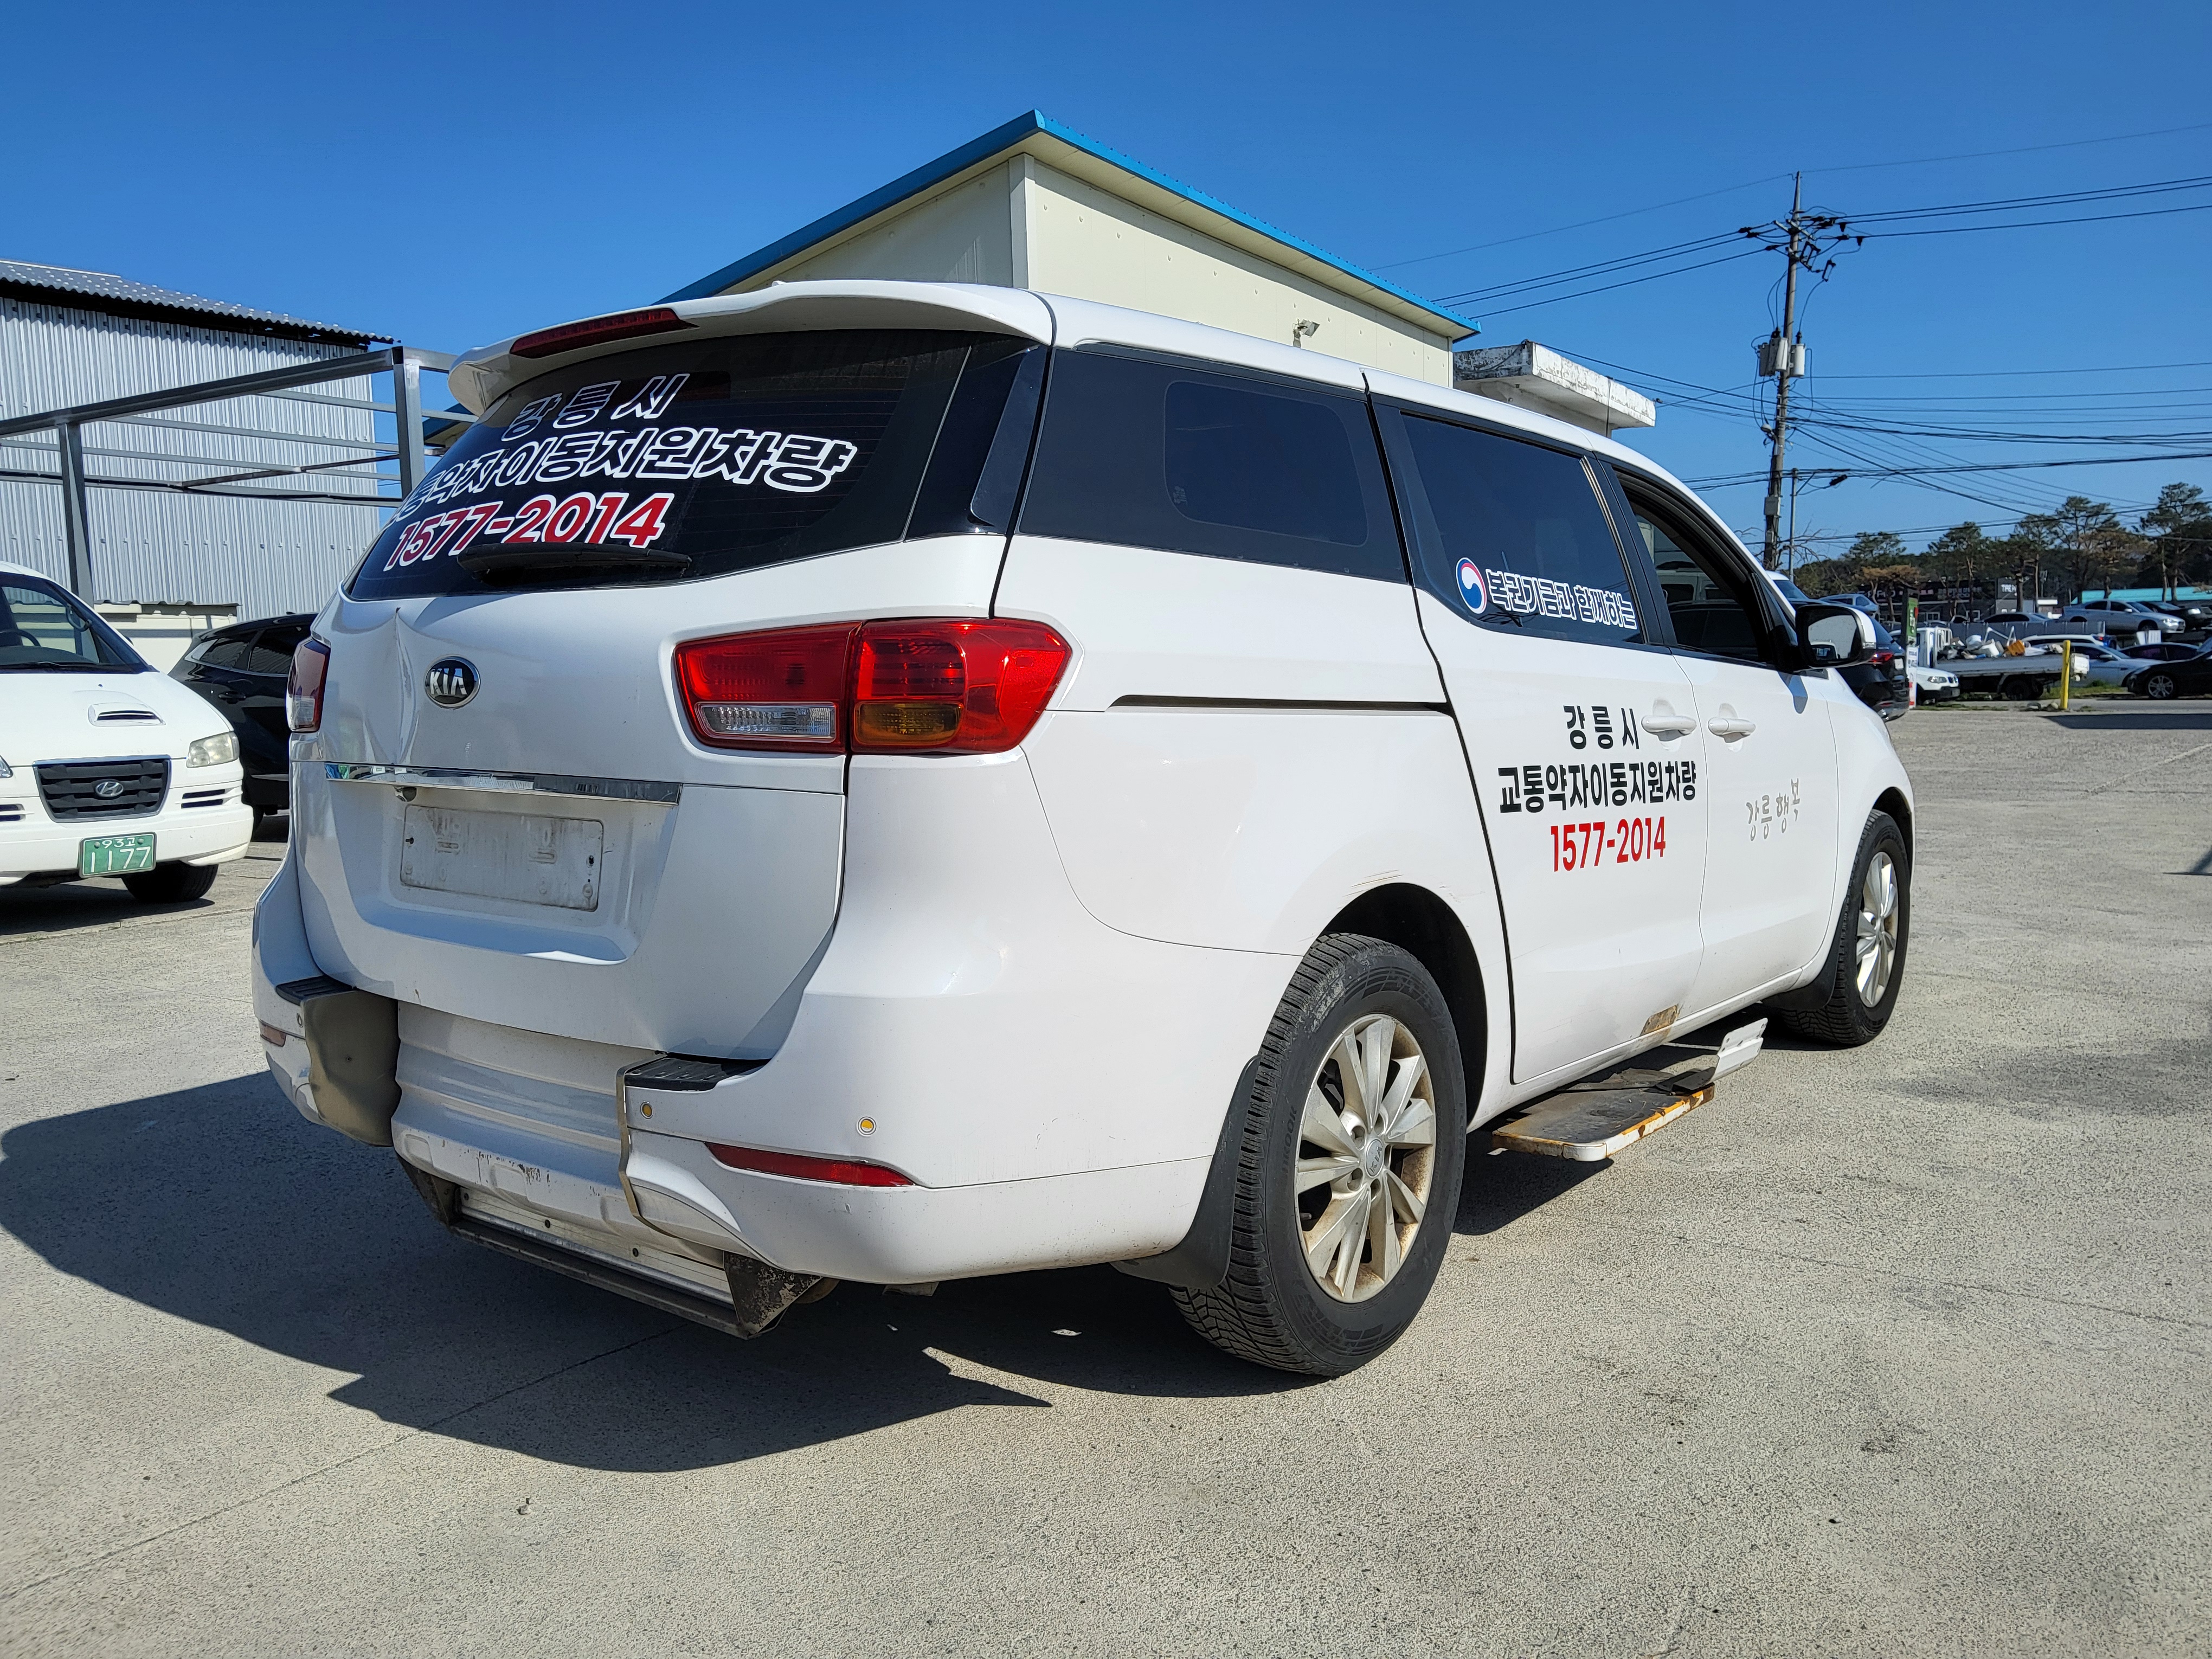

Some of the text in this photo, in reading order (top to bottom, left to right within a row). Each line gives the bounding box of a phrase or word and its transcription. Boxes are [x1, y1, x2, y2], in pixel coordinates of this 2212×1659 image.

[390, 427, 858, 523] 통약자이동지원차량
[383, 492, 675, 572] 1577-2014
[1485, 569, 1637, 629] 복권기금과 함께하는
[430, 668, 467, 695] KIA
[1497, 761, 1696, 813] 교통약자이동지원차량
[91, 846, 151, 873] 1177
[101, 837, 136, 849] 93고
[1551, 816, 1666, 872] 1577-2014
[1369, 1146, 1382, 1173] KIA
